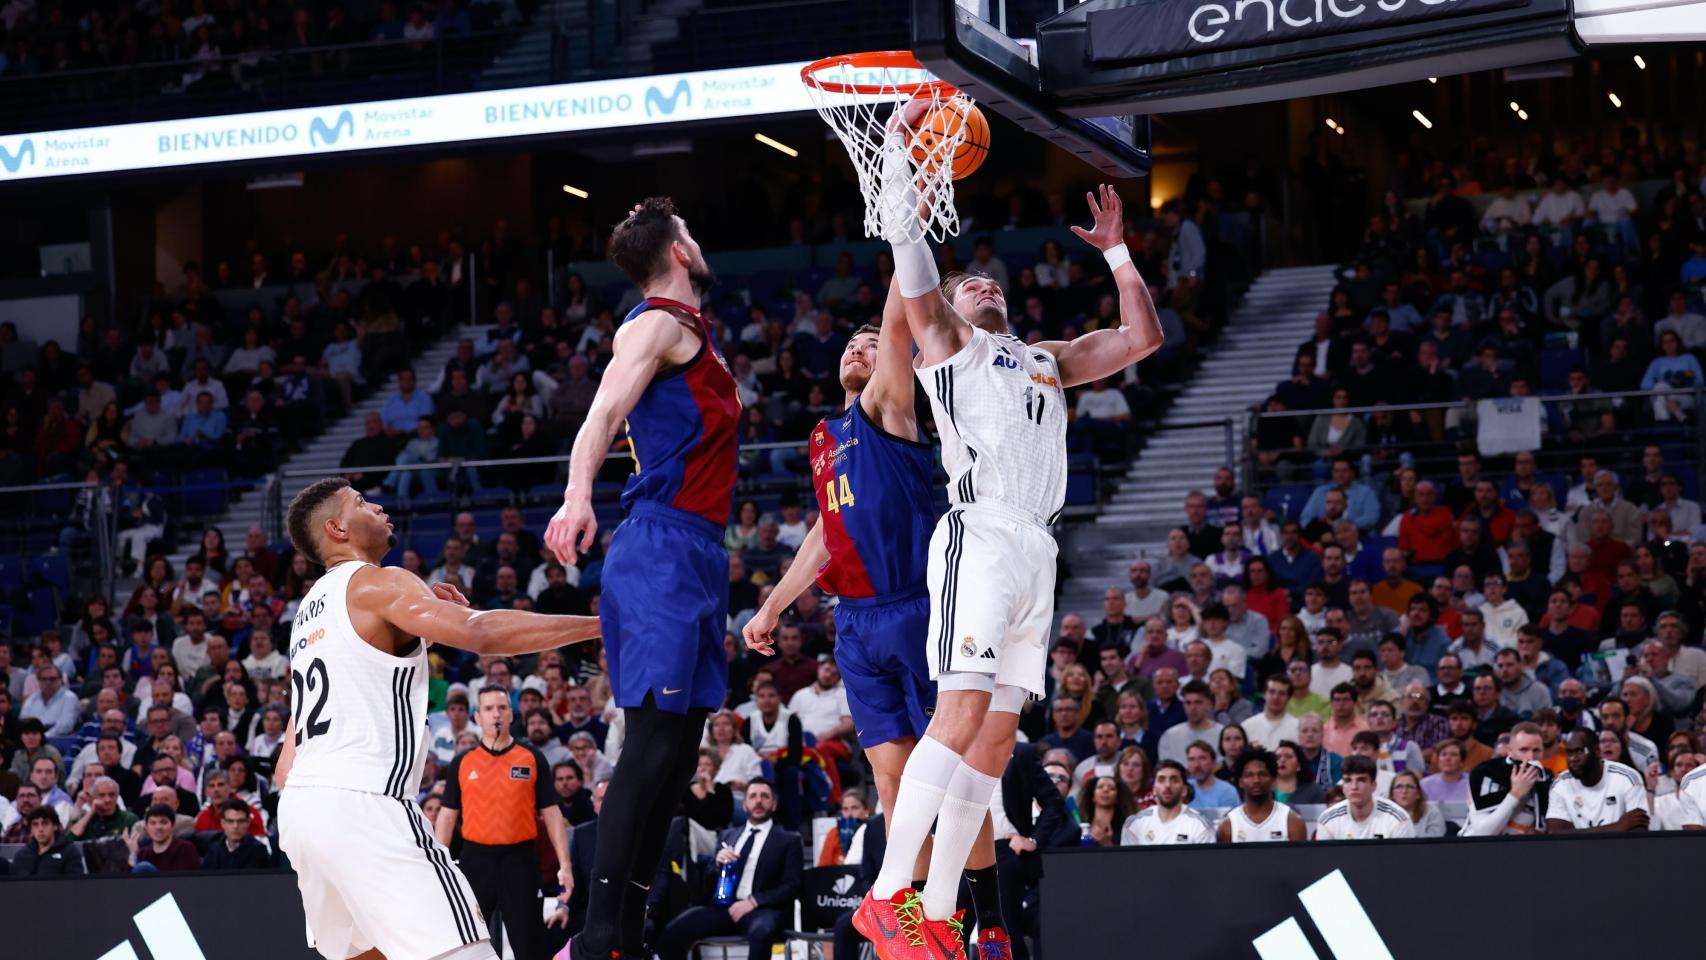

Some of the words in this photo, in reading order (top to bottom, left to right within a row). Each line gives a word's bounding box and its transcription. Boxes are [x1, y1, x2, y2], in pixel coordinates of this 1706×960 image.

[1188, 0, 1452, 43] end
[703, 77, 776, 91] Movistar
[485, 93, 633, 124] BIENVENIDO
[703, 98, 753, 110] Arena
[364, 108, 434, 122] Movistar
[158, 123, 299, 153] BIENVENIDO
[364, 127, 413, 140] Arena
[44, 137, 111, 151] Movistar
[44, 156, 90, 168] Arena
[826, 473, 855, 514] 44
[292, 657, 332, 747] 22
